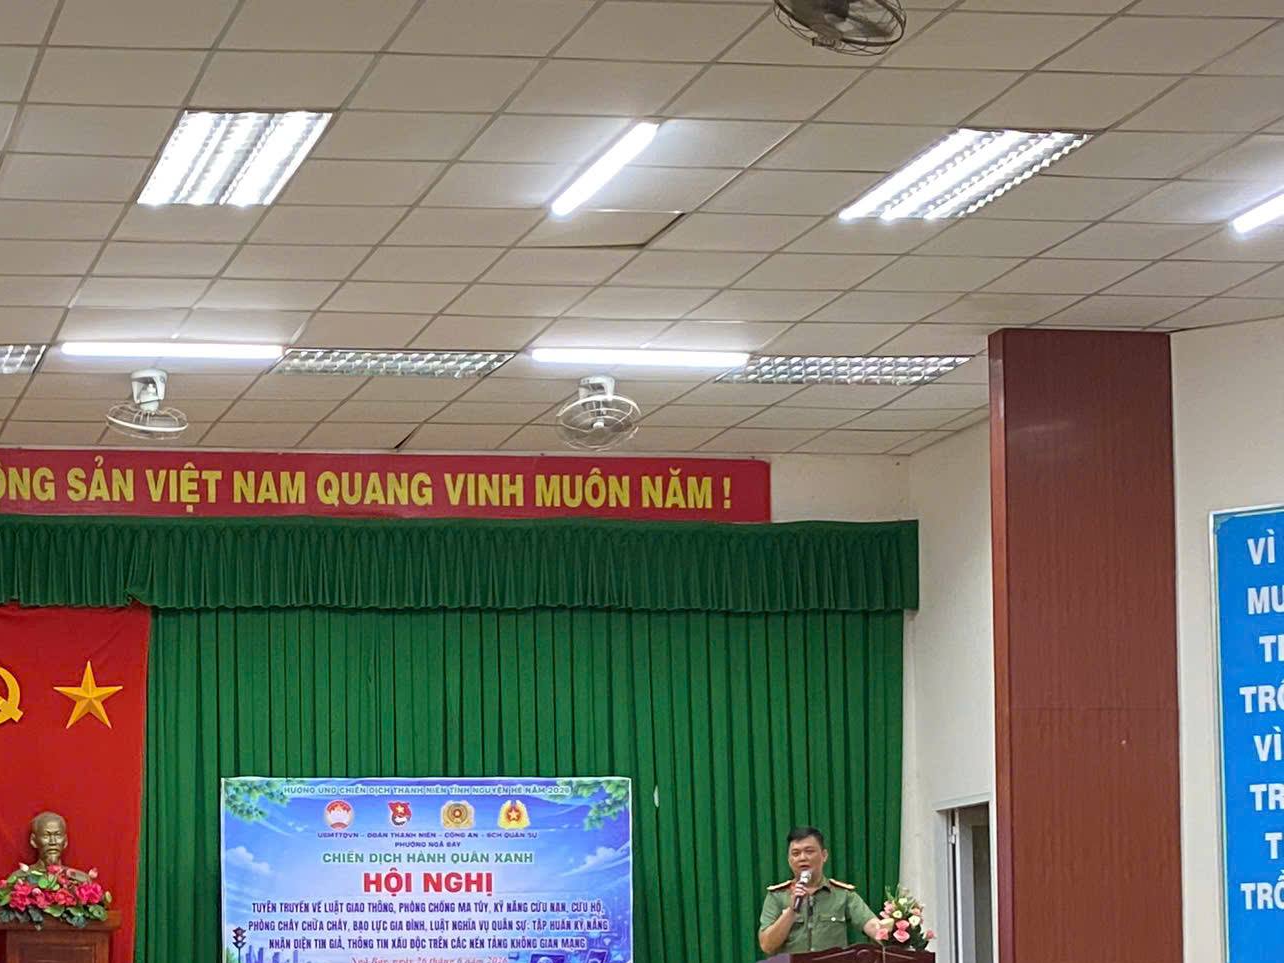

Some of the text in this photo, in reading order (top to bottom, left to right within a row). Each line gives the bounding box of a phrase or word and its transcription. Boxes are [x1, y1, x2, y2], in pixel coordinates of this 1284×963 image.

[66, 455, 134, 501] SẢN
[145, 462, 222, 513] VIỆT
[233, 471, 306, 504] NAM
[316, 471, 433, 507] QUANG
[444, 473, 524, 506] VINH
[535, 467, 630, 508] MUÔN
[642, 468, 712, 509] NĂM
[1247, 529, 1276, 565] VÌ
[1253, 726, 1282, 762] VÌ
[322, 850, 533, 865] CHIẾN DỊCH HÀNH QUÂN XANH
[363, 867, 493, 897] HỘI NGHỊ
[346, 902, 365, 913] GIAO
[458, 902, 472, 913] MA
[390, 921, 403, 931] GIA
[314, 939, 326, 949] TIN
[376, 939, 389, 949] TIN
[540, 938, 558, 948] GIAN
